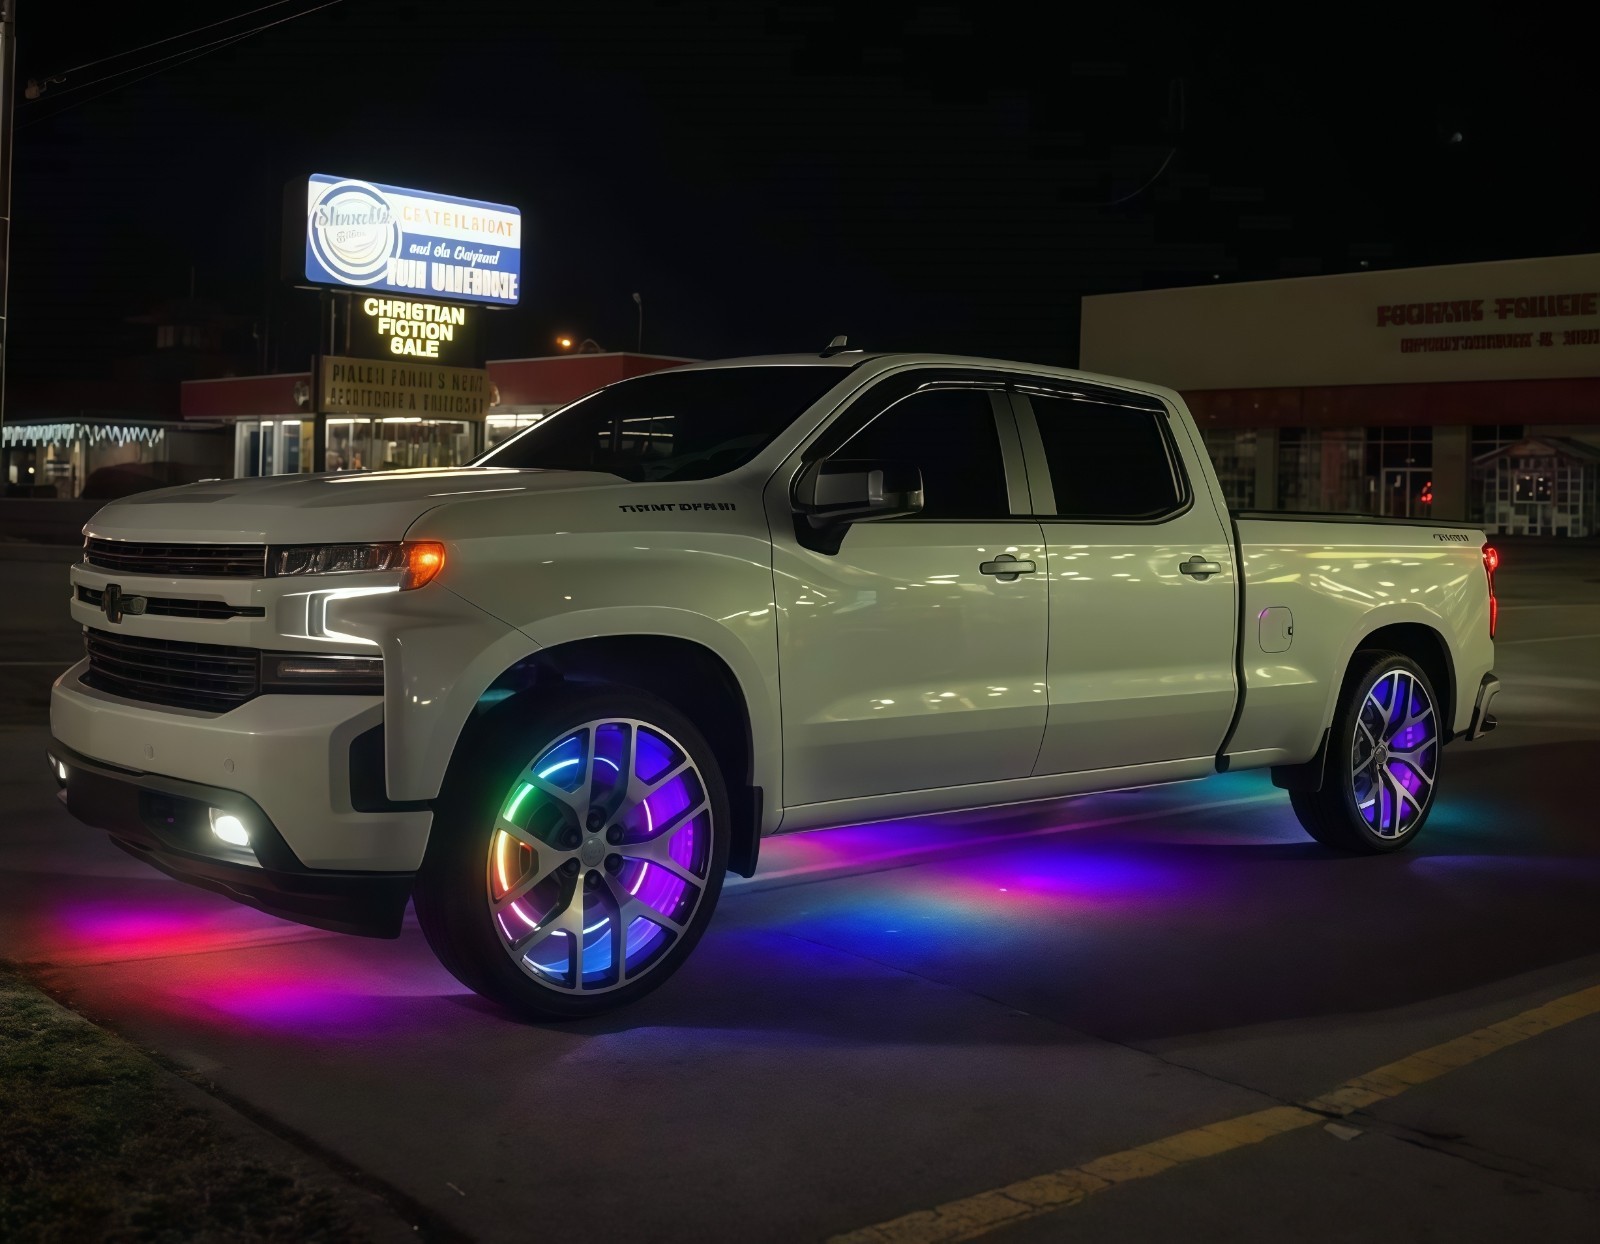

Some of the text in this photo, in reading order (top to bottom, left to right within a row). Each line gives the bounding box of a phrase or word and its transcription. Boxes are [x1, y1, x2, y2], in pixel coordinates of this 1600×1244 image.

[363, 298, 465, 325] CHRISTIAN
[378, 317, 454, 341] FICTION
[390, 336, 440, 358] SALE
